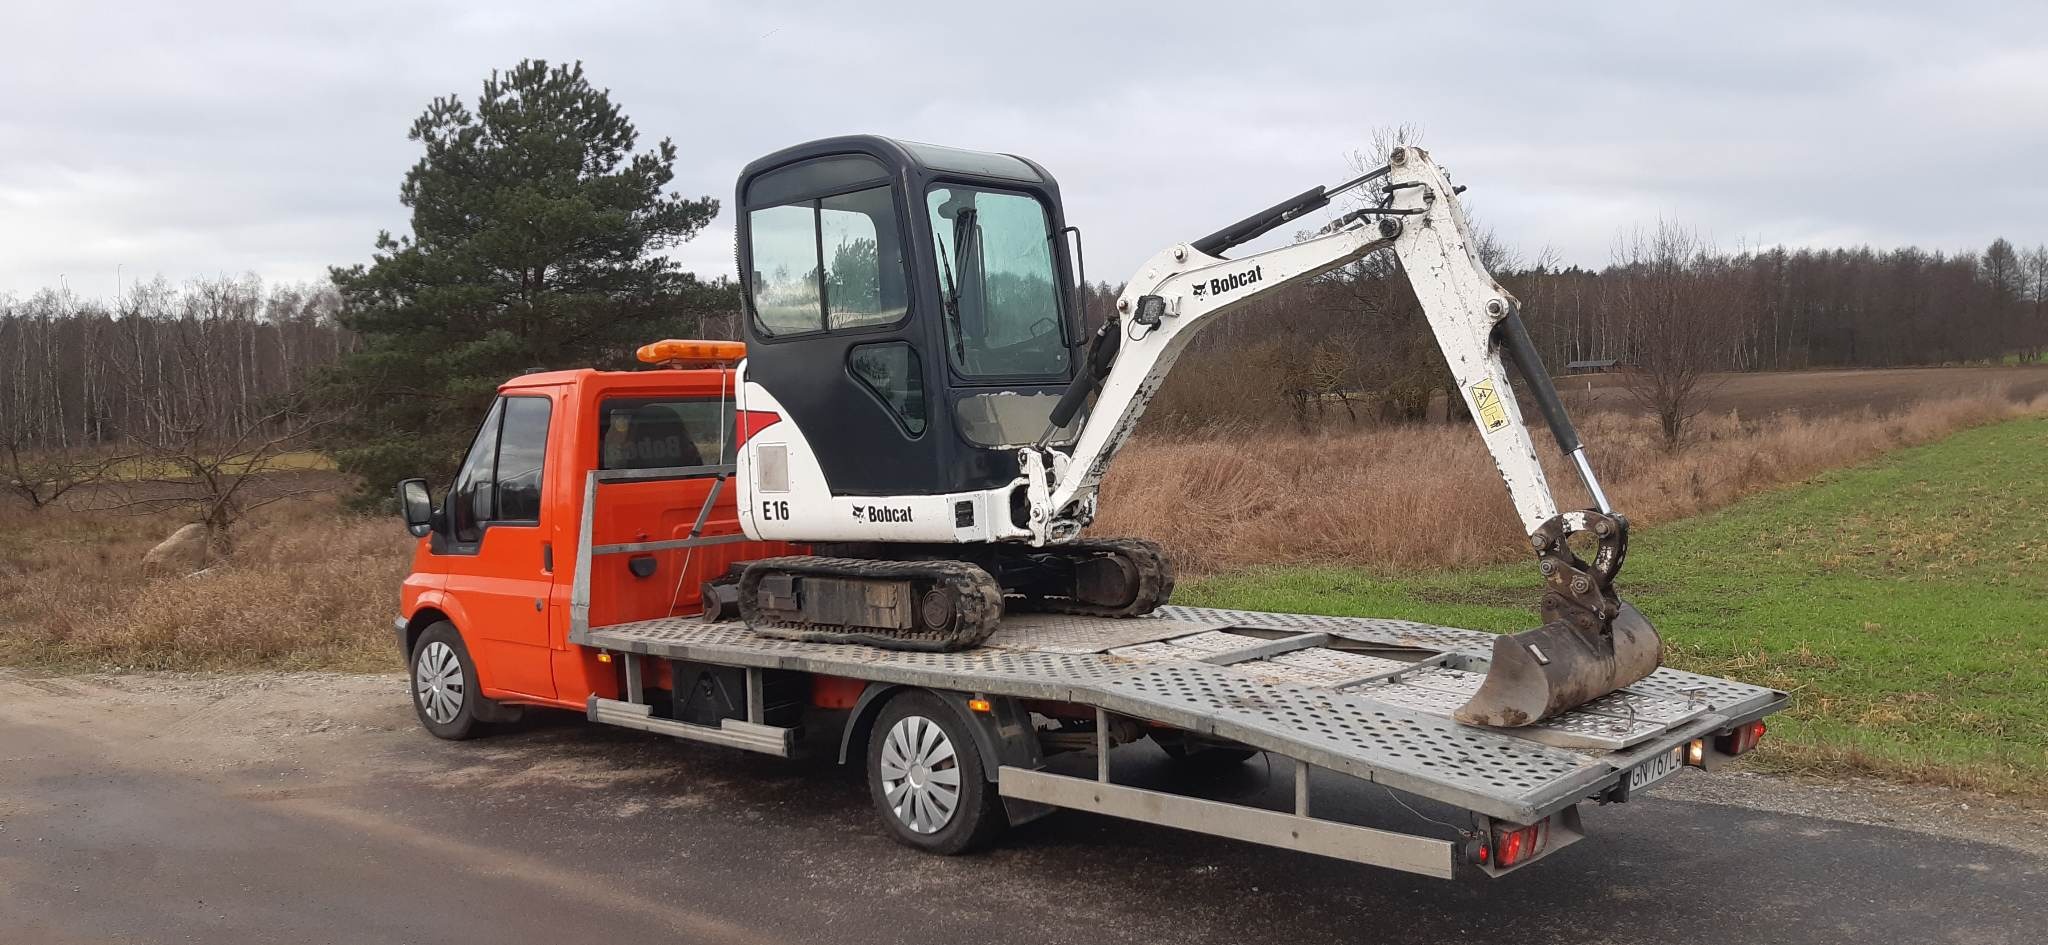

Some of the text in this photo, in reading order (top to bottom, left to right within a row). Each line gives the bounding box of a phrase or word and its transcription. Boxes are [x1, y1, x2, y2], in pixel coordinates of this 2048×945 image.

[1210, 265, 1262, 296] Bobcat
[762, 501, 790, 521] E16
[869, 506, 913, 523] Bobcat
